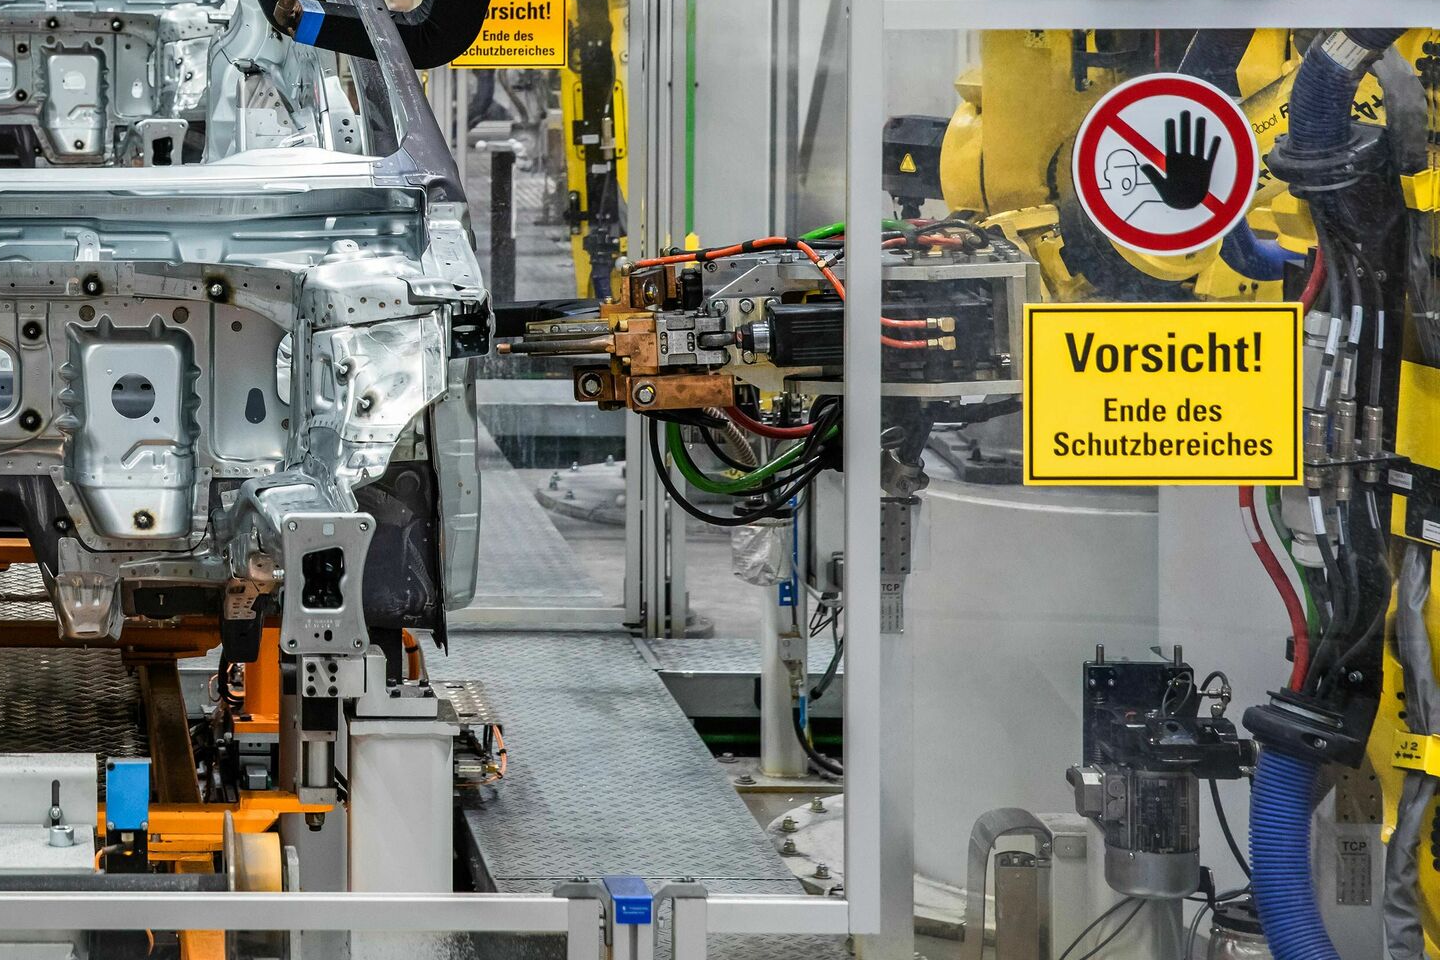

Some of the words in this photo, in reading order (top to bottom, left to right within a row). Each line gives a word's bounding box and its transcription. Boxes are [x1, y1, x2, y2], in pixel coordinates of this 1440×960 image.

[483, 30, 510, 41] Ende
[514, 30, 534, 41] des
[1065, 331, 1262, 373] Vorsicht!
[1104, 398, 1166, 422] Ende
[1177, 398, 1222, 422] des
[1053, 432, 1273, 456] Schutzbereiches
[881, 583, 900, 591] TCP
[1342, 841, 1367, 852] TCP
